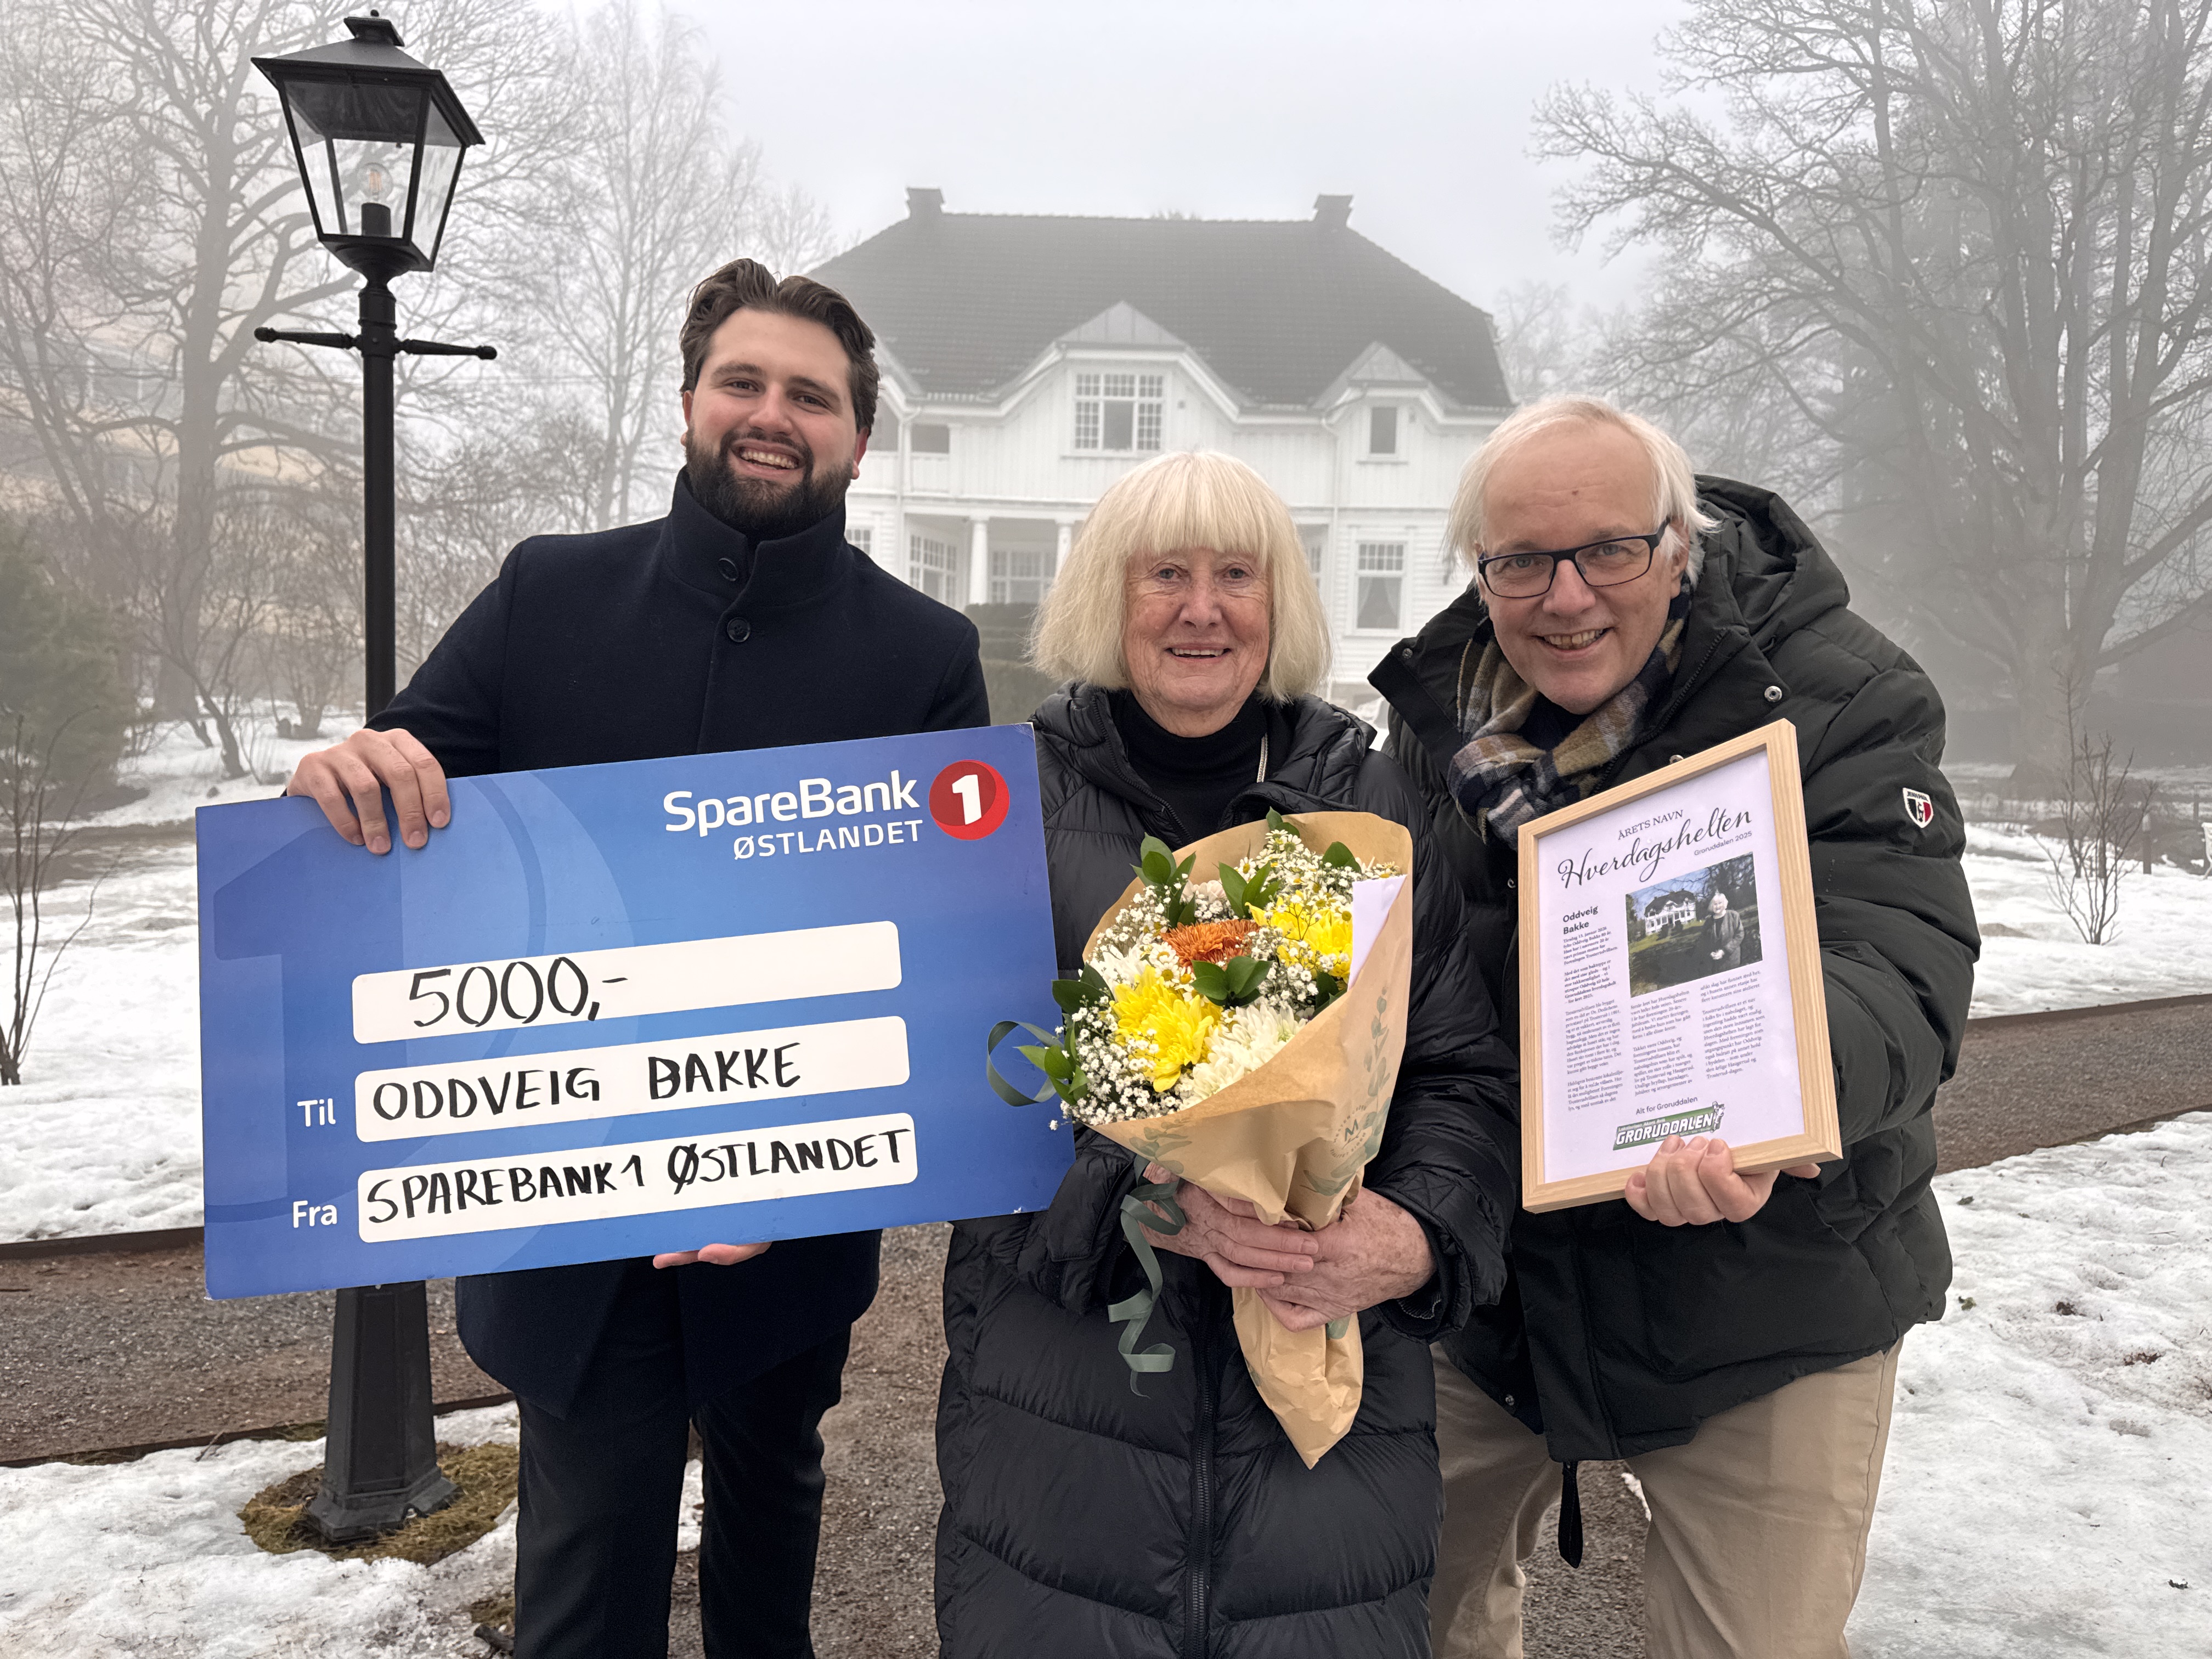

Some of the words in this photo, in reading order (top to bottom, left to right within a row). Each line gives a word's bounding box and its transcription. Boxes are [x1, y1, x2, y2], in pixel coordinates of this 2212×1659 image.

[664, 770, 920, 837] SpareBank
[952, 775, 981, 825] 1
[734, 820, 922, 860] ØSTLANDET
[1618, 820, 1650, 840] ÅRETS
[1652, 810, 1683, 826] NAVN
[1558, 807, 1751, 888] Hverdagshelten
[1694, 838, 1733, 855] Groruddalen
[1735, 831, 1752, 841] 2025
[1562, 906, 1598, 922] Oddveig
[1564, 922, 1589, 934] Bakke
[409, 957, 628, 1028] 5000,-
[373, 1068, 600, 1120] ODDVEIG
[648, 1043, 800, 1100] BAKKE
[297, 1098, 336, 1127] Til
[1657, 1097, 1697, 1108] Groruddalen
[1616, 1113, 1713, 1145] GRORUDDALEN
[668, 1128, 910, 1195] ØSTLANDET
[293, 1200, 337, 1228] Fra
